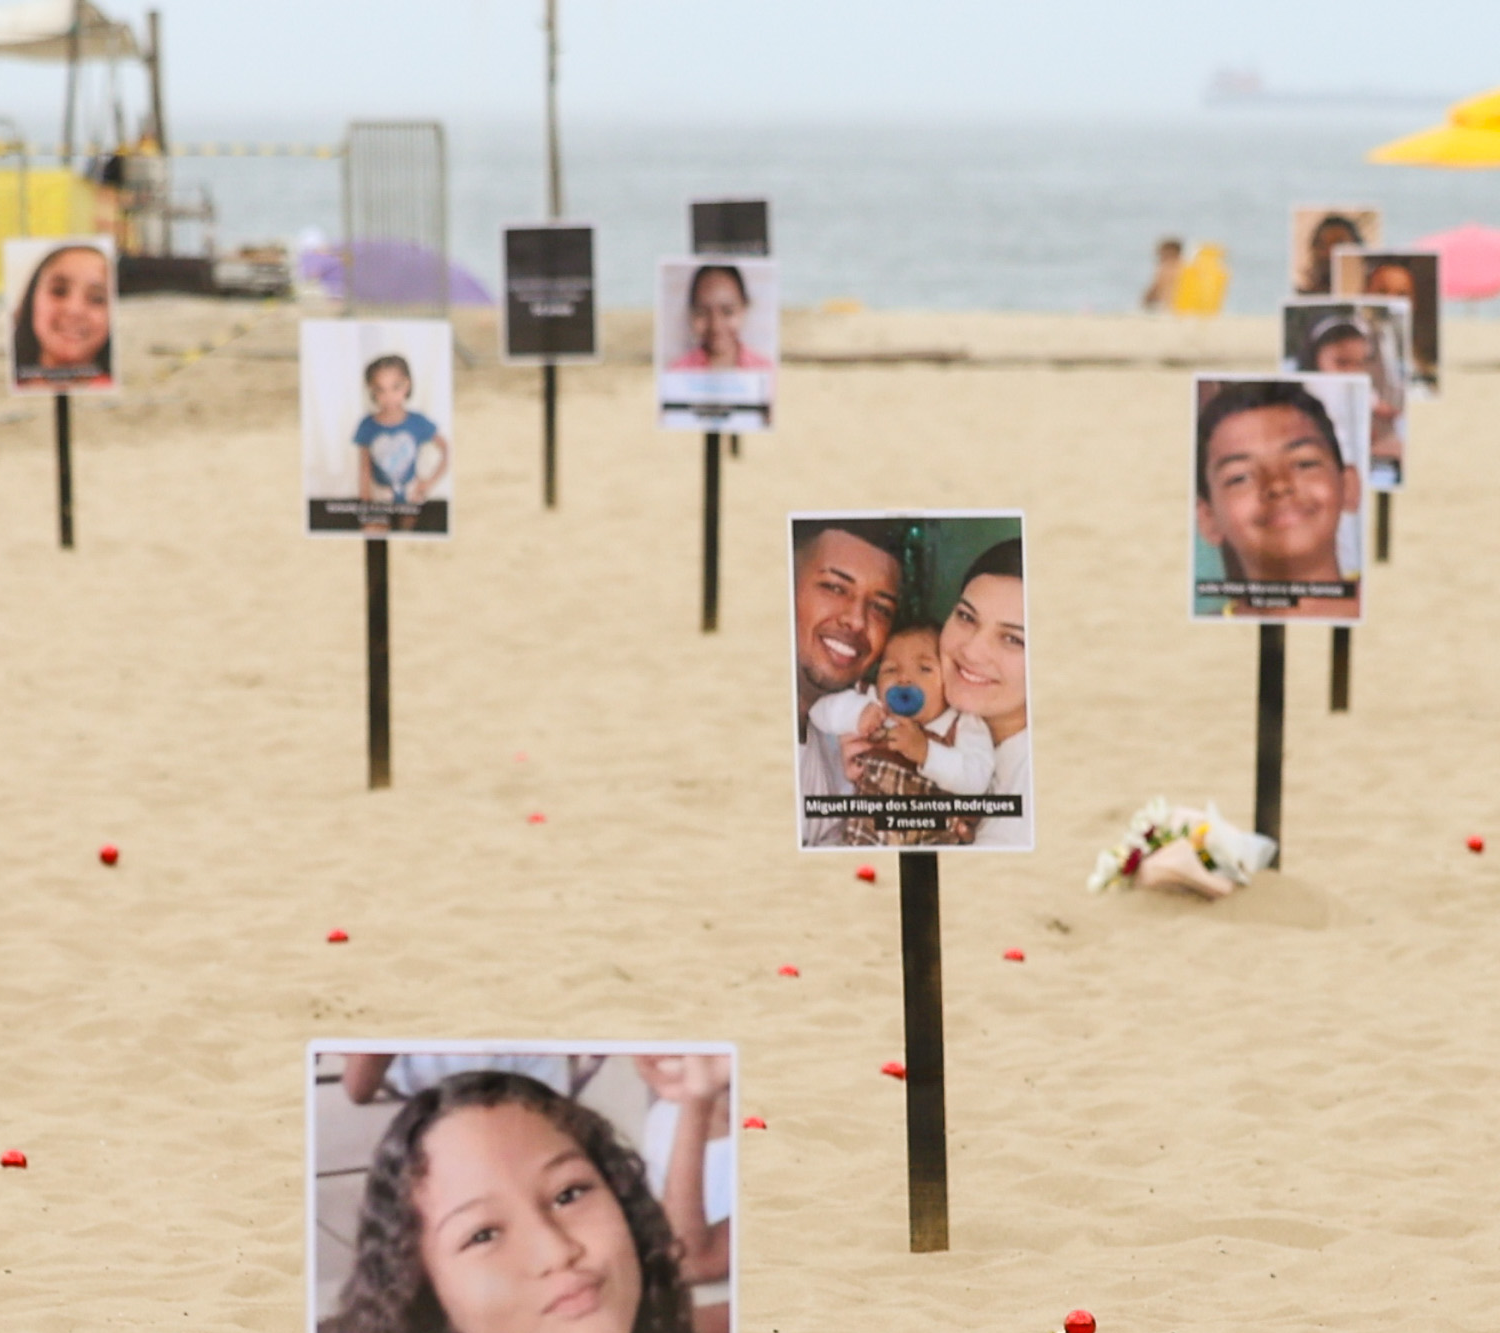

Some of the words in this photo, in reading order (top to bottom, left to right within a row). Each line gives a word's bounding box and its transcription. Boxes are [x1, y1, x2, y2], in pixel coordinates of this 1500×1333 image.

[805, 799, 848, 815] Miguel
[849, 799, 883, 815] Filipe
[885, 799, 908, 812] dos
[910, 799, 951, 812] Santos
[953, 799, 1015, 814] Rodrigues
[886, 816, 894, 828] 7
[896, 818, 936, 828] meses
